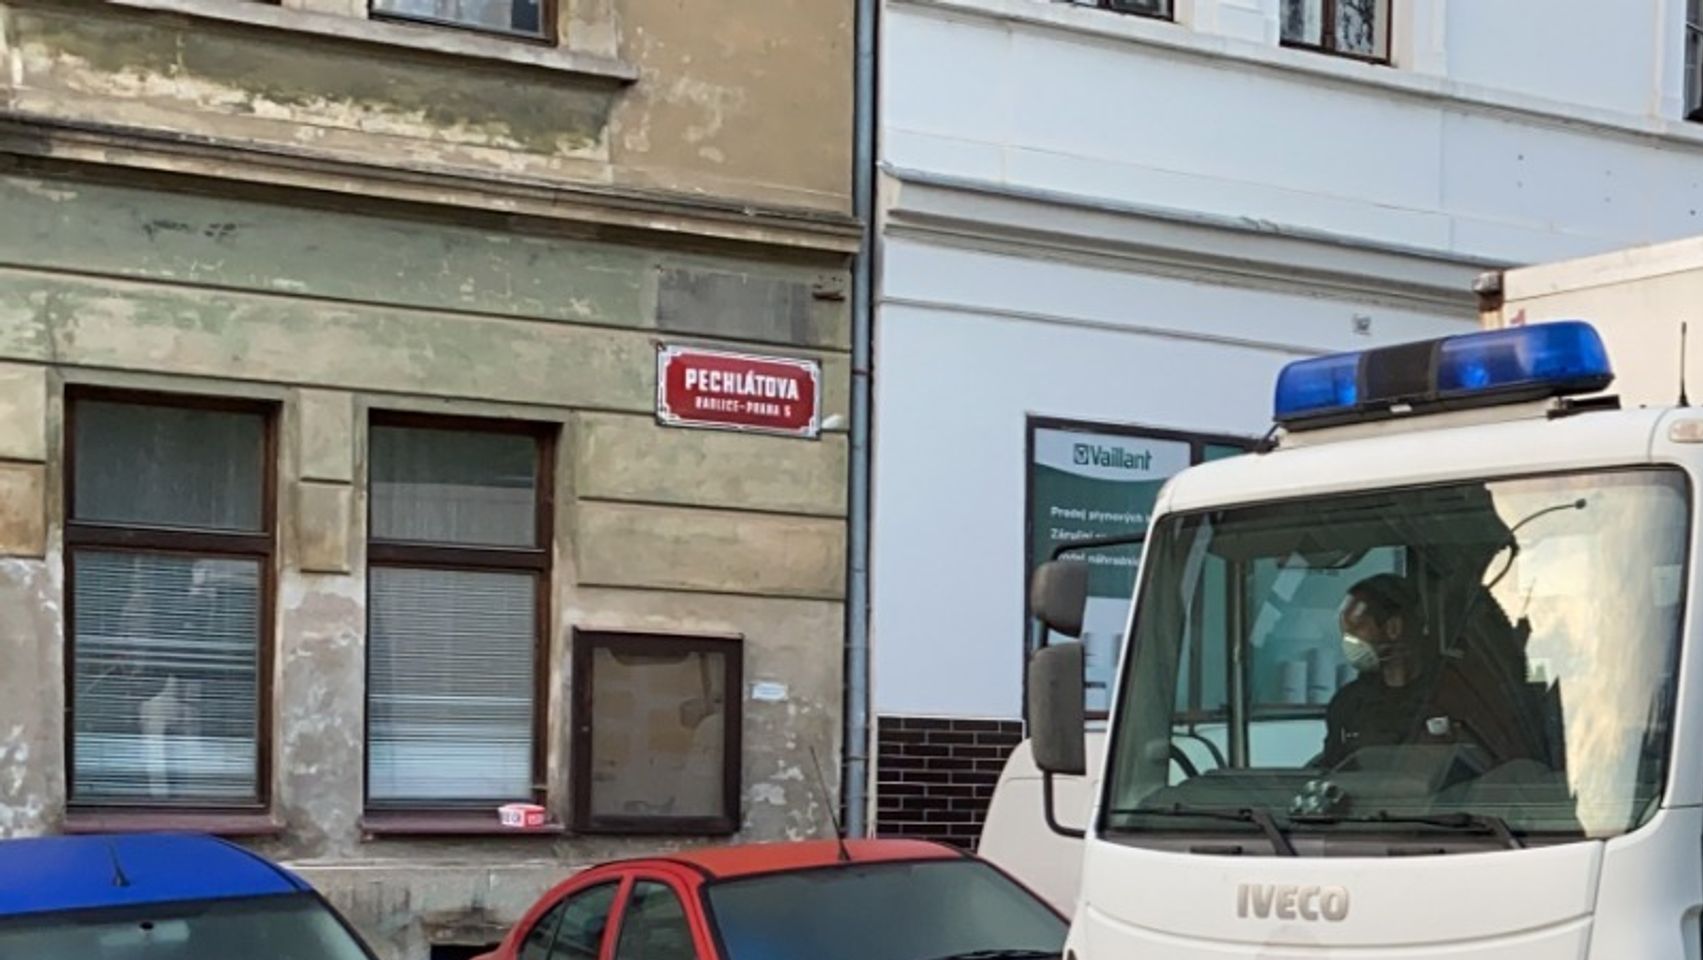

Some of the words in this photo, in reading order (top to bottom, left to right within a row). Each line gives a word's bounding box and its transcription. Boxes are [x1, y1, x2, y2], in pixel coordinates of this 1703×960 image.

[685, 367, 799, 400] PECHLÁTOVA
[1092, 444, 1152, 471] Vaillant
[1237, 883, 1350, 922] IVECO
